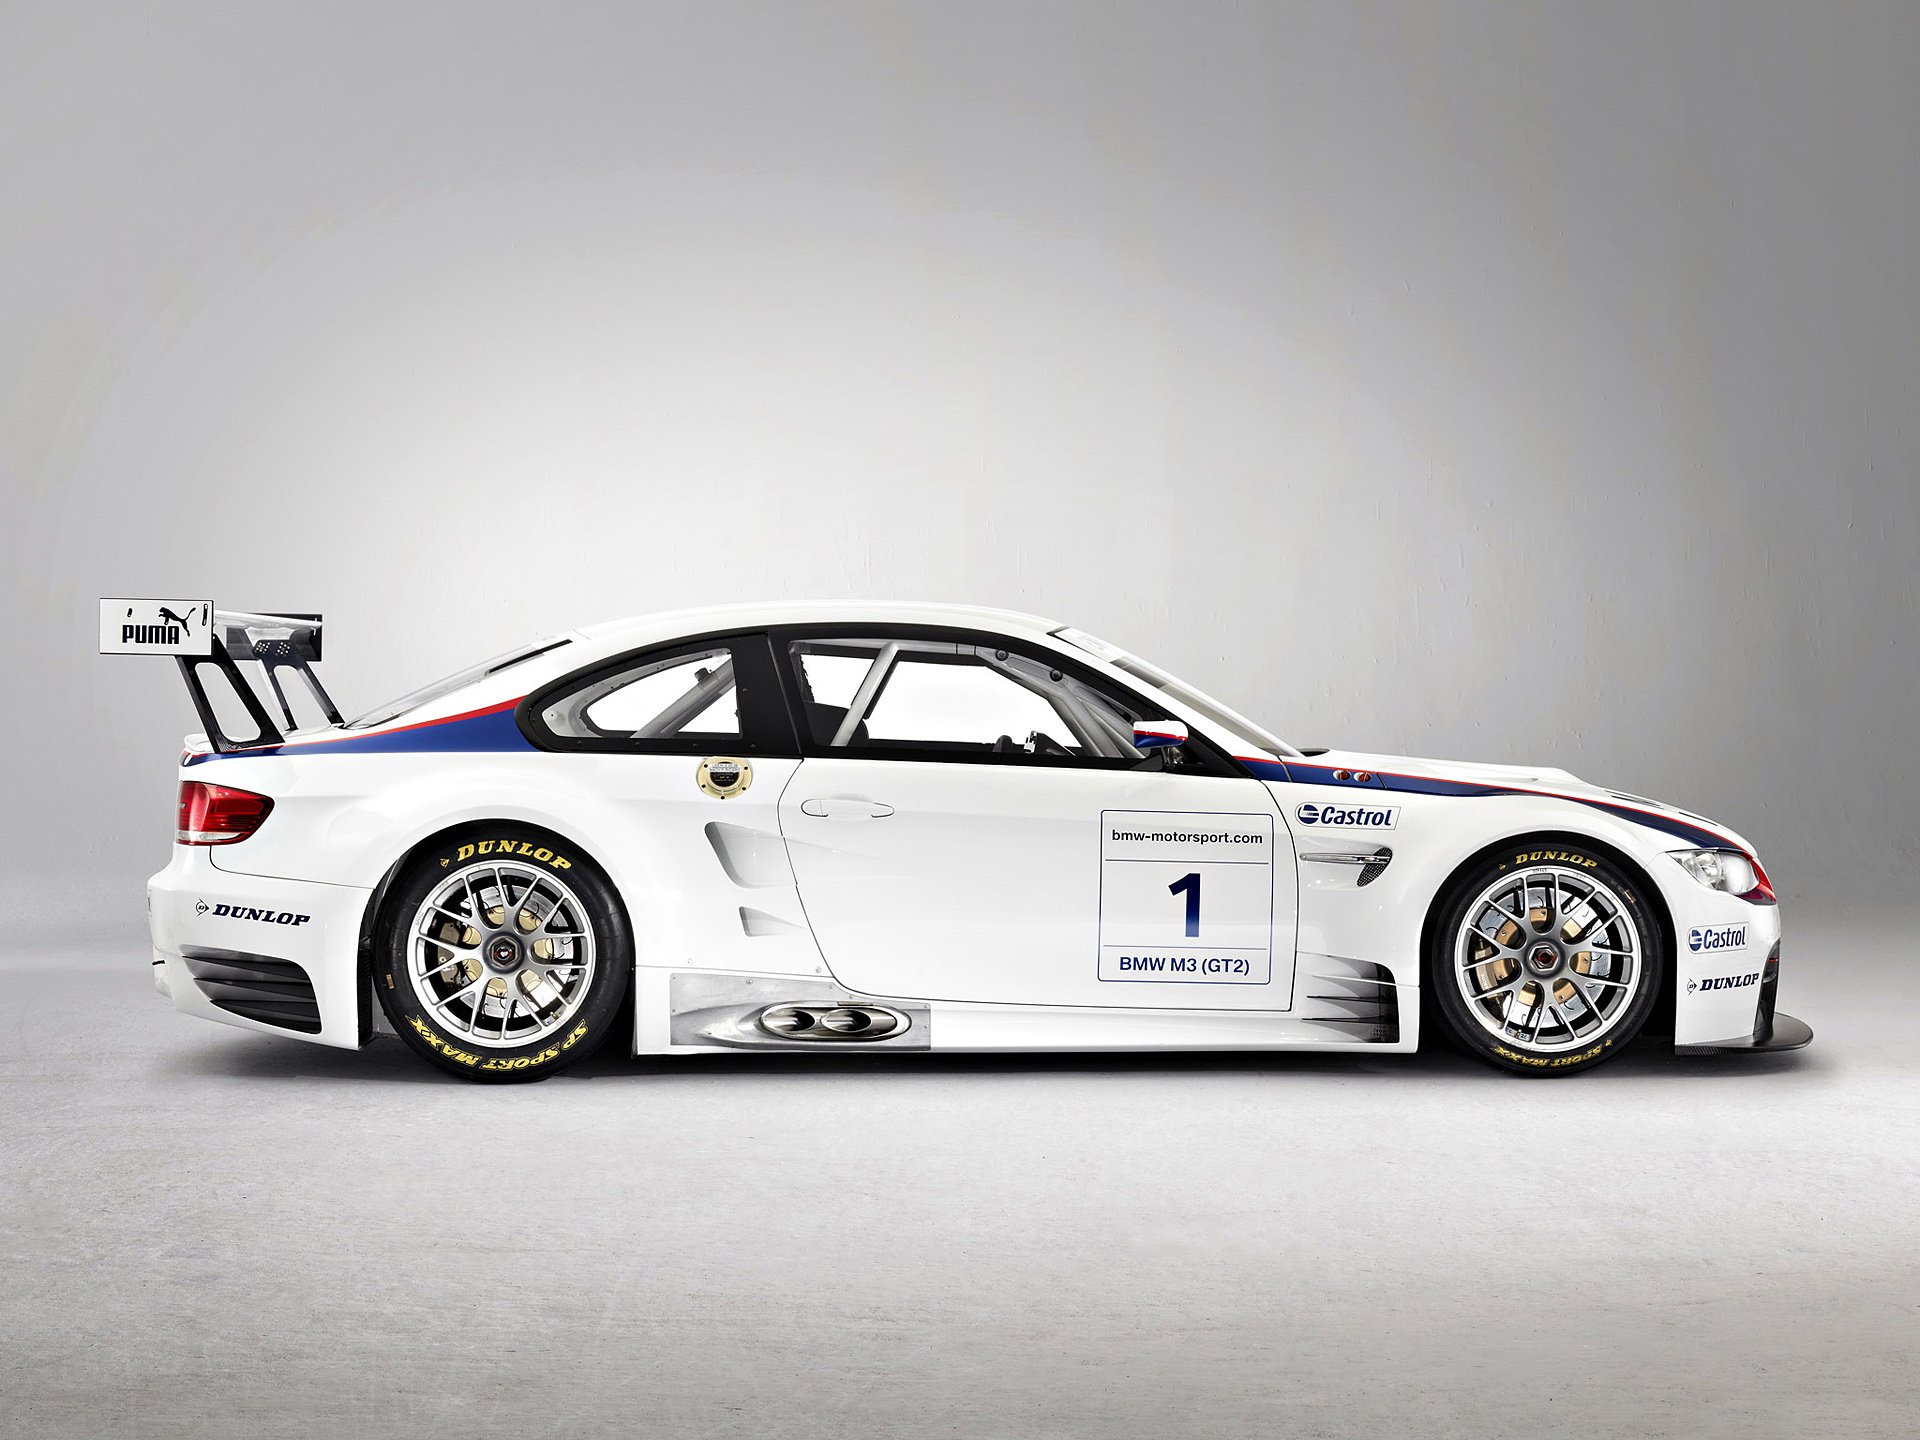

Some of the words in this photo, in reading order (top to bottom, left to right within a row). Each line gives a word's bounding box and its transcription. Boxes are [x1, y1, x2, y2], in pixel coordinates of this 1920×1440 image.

[122, 625, 180, 645] PUMA
[1320, 806, 1392, 826] Castrol
[1112, 829, 1263, 845] bmw-motorsport.com
[457, 840, 572, 869] DUNLOP
[1515, 851, 1598, 868] DUNLOP
[212, 903, 311, 926] DUNLOP
[1168, 873, 1201, 938] 1
[1703, 926, 1746, 950] Castrol
[1119, 957, 1166, 971] BMW
[1170, 958, 1197, 972] M3
[1201, 958, 1250, 976] (GT2)
[1699, 972, 1760, 991] DUNLOP
[405, 1014, 482, 1068] MAXX
[562, 1019, 589, 1051] SP
[479, 1042, 561, 1071] SPORT
